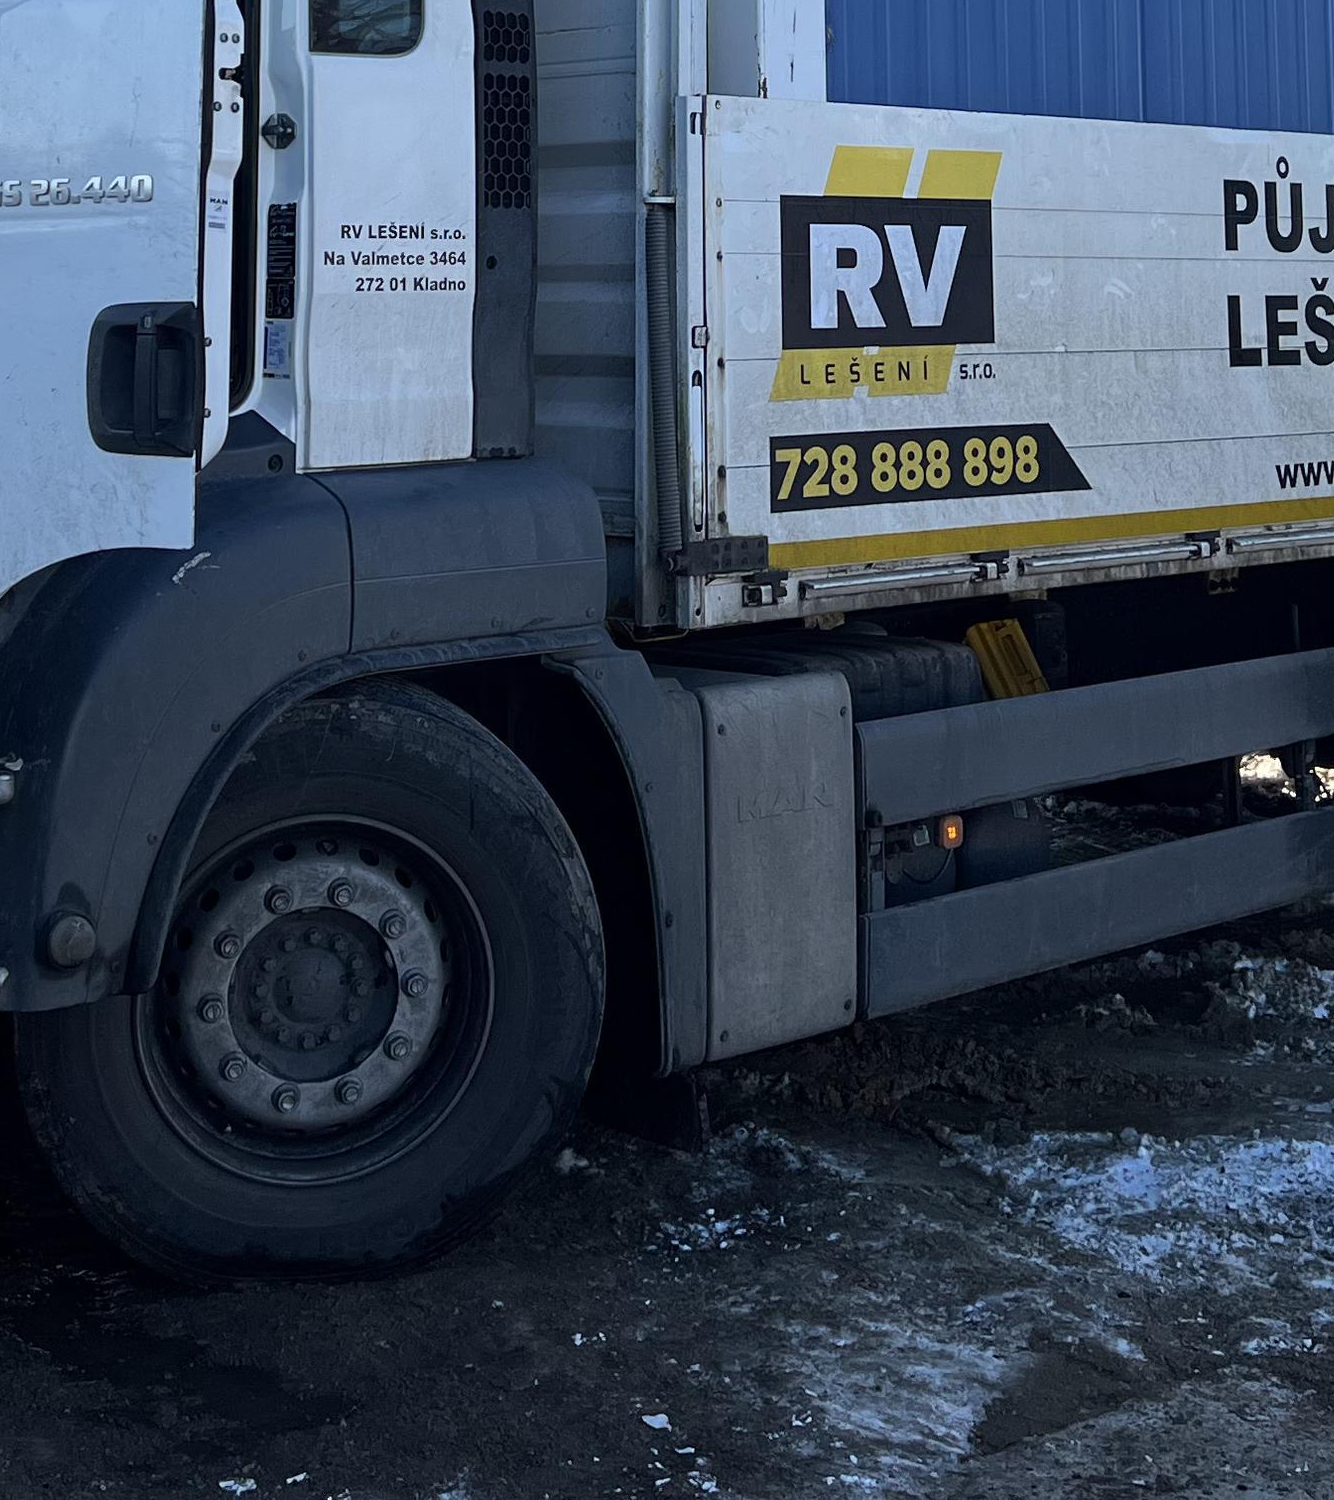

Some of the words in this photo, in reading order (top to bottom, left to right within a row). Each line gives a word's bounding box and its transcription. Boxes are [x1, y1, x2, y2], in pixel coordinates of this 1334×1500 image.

[30, 174, 154, 207] 26.440
[341, 224, 362, 239] RV
[368, 222, 425, 239] LEŠENÍ
[430, 228, 466, 240] s.r.o.
[324, 251, 345, 265] Na
[351, 251, 425, 265] Valmetce
[429, 251, 466, 265] 3464
[355, 277, 384, 292] 272
[389, 277, 407, 292] 01
[413, 277, 466, 291] Kladno
[808, 223, 968, 329] RV
[799, 354, 929, 385] LEŠENÍ
[959, 362, 997, 380] s.r.o.
[775, 444, 859, 501] 728
[871, 439, 951, 493] 888
[963, 434, 1040, 489] 898
